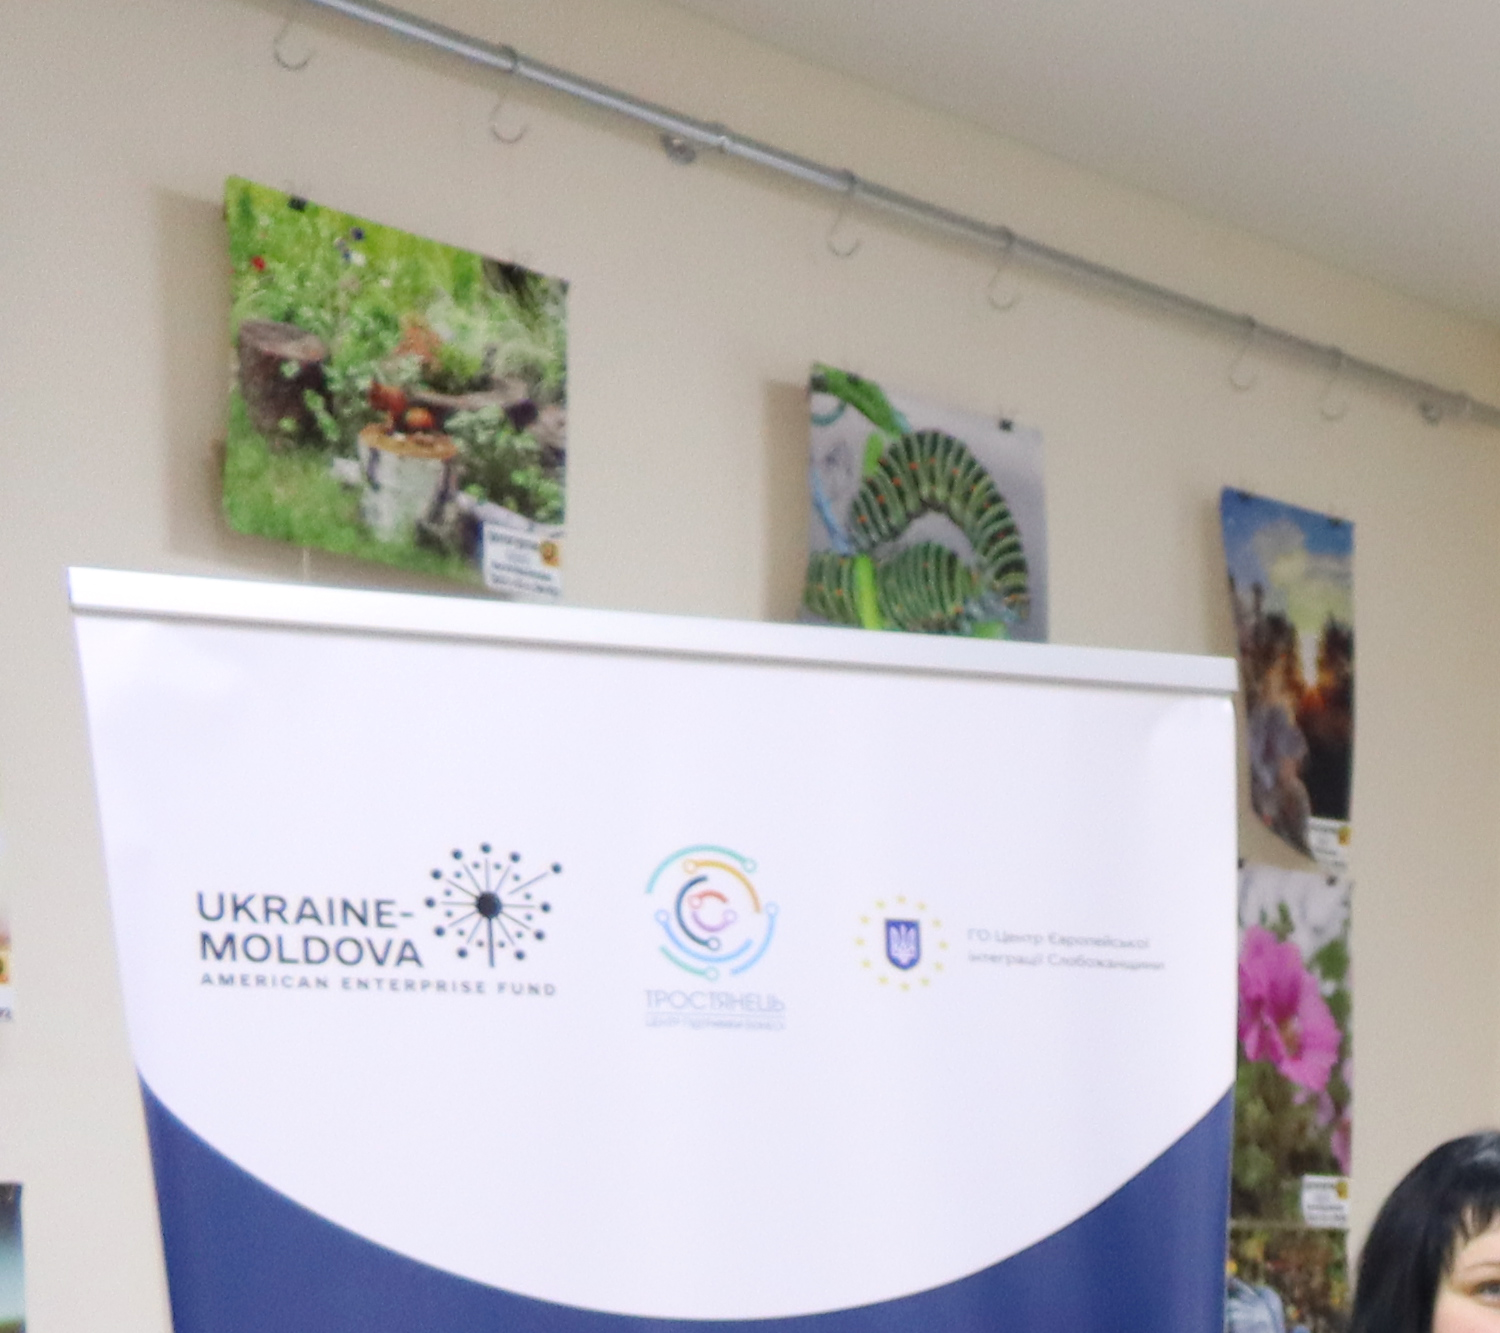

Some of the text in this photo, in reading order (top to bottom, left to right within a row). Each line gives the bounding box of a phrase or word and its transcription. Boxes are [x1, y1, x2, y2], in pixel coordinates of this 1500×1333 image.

[196, 889, 415, 929] UKRAINE-
[200, 930, 424, 968] MOLDOVA
[201, 972, 556, 997] AMERICAN ENTERPRISE FUND
